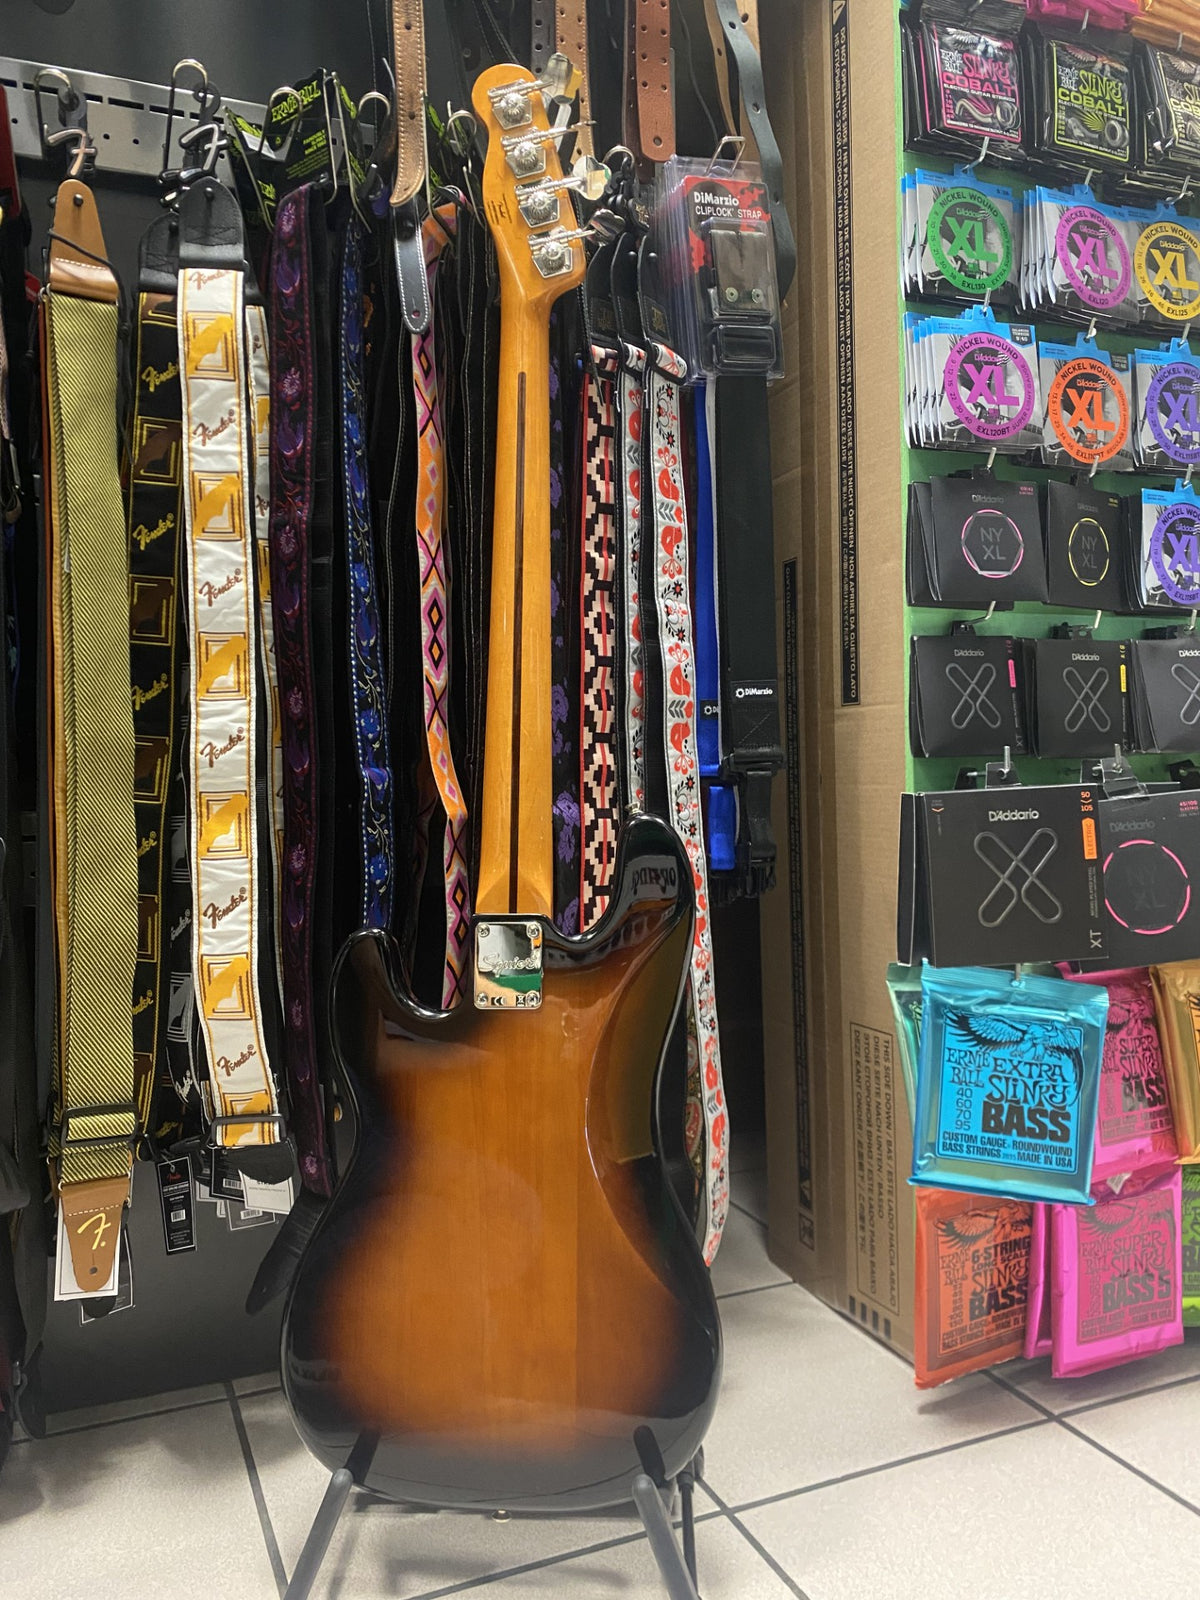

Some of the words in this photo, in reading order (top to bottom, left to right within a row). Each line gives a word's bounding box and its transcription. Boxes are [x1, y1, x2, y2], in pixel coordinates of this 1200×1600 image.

[942, 72, 1013, 97] COBALT
[1058, 88, 1125, 117] COBALT
[693, 191, 740, 207] DiMarzio
[940, 191, 966, 208] NICKEL
[968, 192, 998, 217] WOUND
[695, 206, 733, 219] CLIPLOCK
[737, 210, 762, 220] STRAP
[1064, 210, 1088, 225] NICKEL
[1090, 213, 1117, 237] WOUND
[945, 216, 998, 263] XL
[1144, 225, 1169, 240] NICKEL
[1170, 227, 1199, 249] WOUND
[1070, 232, 1119, 281] XL
[1149, 248, 1200, 291] XL
[961, 280, 986, 290] EXL130
[1166, 306, 1188, 316] EXL125
[956, 337, 985, 356] NICKEL
[986, 337, 1018, 360] WOUND
[962, 363, 1020, 407] XL
[1061, 362, 1087, 380] NICKEL
[1089, 362, 1116, 386] WOUND
[1157, 367, 1182, 384] NICKEL
[1066, 388, 1116, 431] XL
[1162, 391, 1200, 431] XL
[193, 413, 236, 447] Fender
[976, 425, 1010, 436] EXL120BT
[1161, 508, 1184, 526] NICKEL
[132, 518, 174, 550] Fender
[980, 527, 1003, 542] NY
[1081, 535, 1098, 552] NY
[982, 545, 1006, 560] XL
[1082, 553, 1097, 569] XL
[199, 573, 243, 607] Fender
[954, 649, 985, 657] D'Addario
[1071, 653, 1100, 661] D'Addario
[745, 687, 773, 696] DiMarzio
[199, 732, 245, 768] Fender
[1080, 791, 1091, 799] 50
[988, 808, 1040, 822] D'Addario
[1080, 804, 1094, 812] 105
[1109, 819, 1156, 832] D'Addario
[203, 892, 247, 929] Fender
[1089, 929, 1103, 949] XT
[1120, 1034, 1157, 1055] SUPER
[217, 1050, 257, 1077] Fender
[945, 1047, 992, 1069] ERNIE
[950, 1066, 984, 1088] BALL
[992, 1057, 1069, 1083] EXTRA
[956, 1087, 973, 1098] 40
[955, 1109, 972, 1120] 70
[956, 1099, 972, 1109] 60
[955, 1120, 971, 1131] 95
[981, 1100, 1071, 1144] BASS
[942, 1130, 978, 1145] CUSTOM
[980, 1135, 1008, 1149] GAUGE
[1012, 1139, 1073, 1157] ROUNDWOUND
[942, 1141, 964, 1153] BASS
[966, 1145, 1002, 1158] STRINGS
[1017, 1151, 1041, 1164] MADE
[1044, 1154, 1053, 1165] IN
[1055, 1156, 1073, 1168] USA
[1113, 1230, 1167, 1255] SUPER
[969, 1283, 1028, 1321] BASS
[1103, 1273, 1155, 1313] BASS
